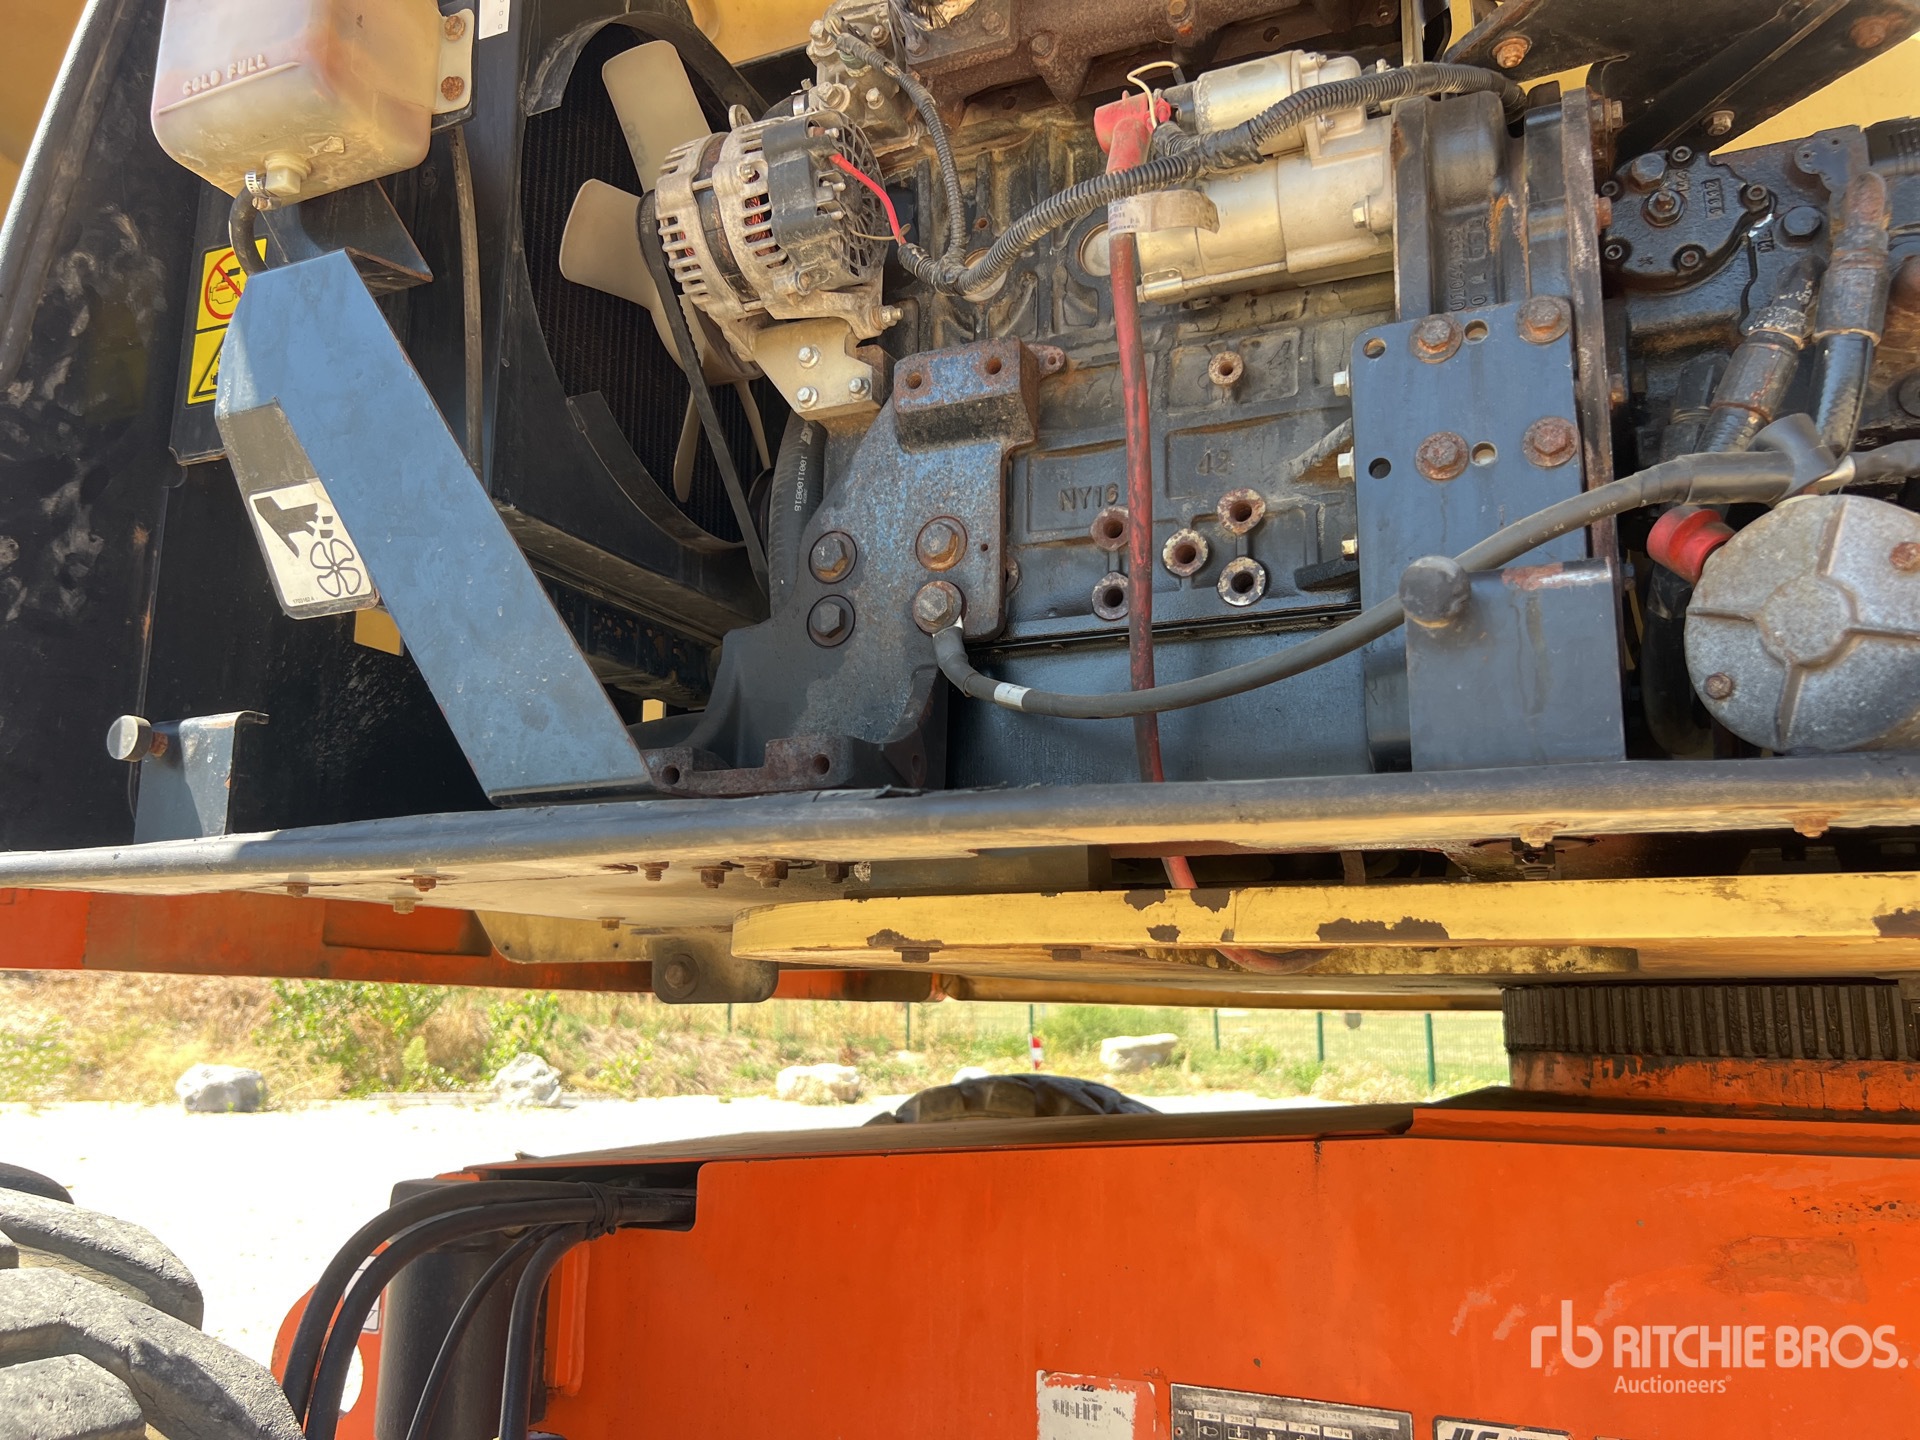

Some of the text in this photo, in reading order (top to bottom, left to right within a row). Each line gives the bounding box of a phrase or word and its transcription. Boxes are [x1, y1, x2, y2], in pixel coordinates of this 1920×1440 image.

[183, 54, 267, 96] COLD FULL
[1178, 1409, 1193, 1417] MAX
